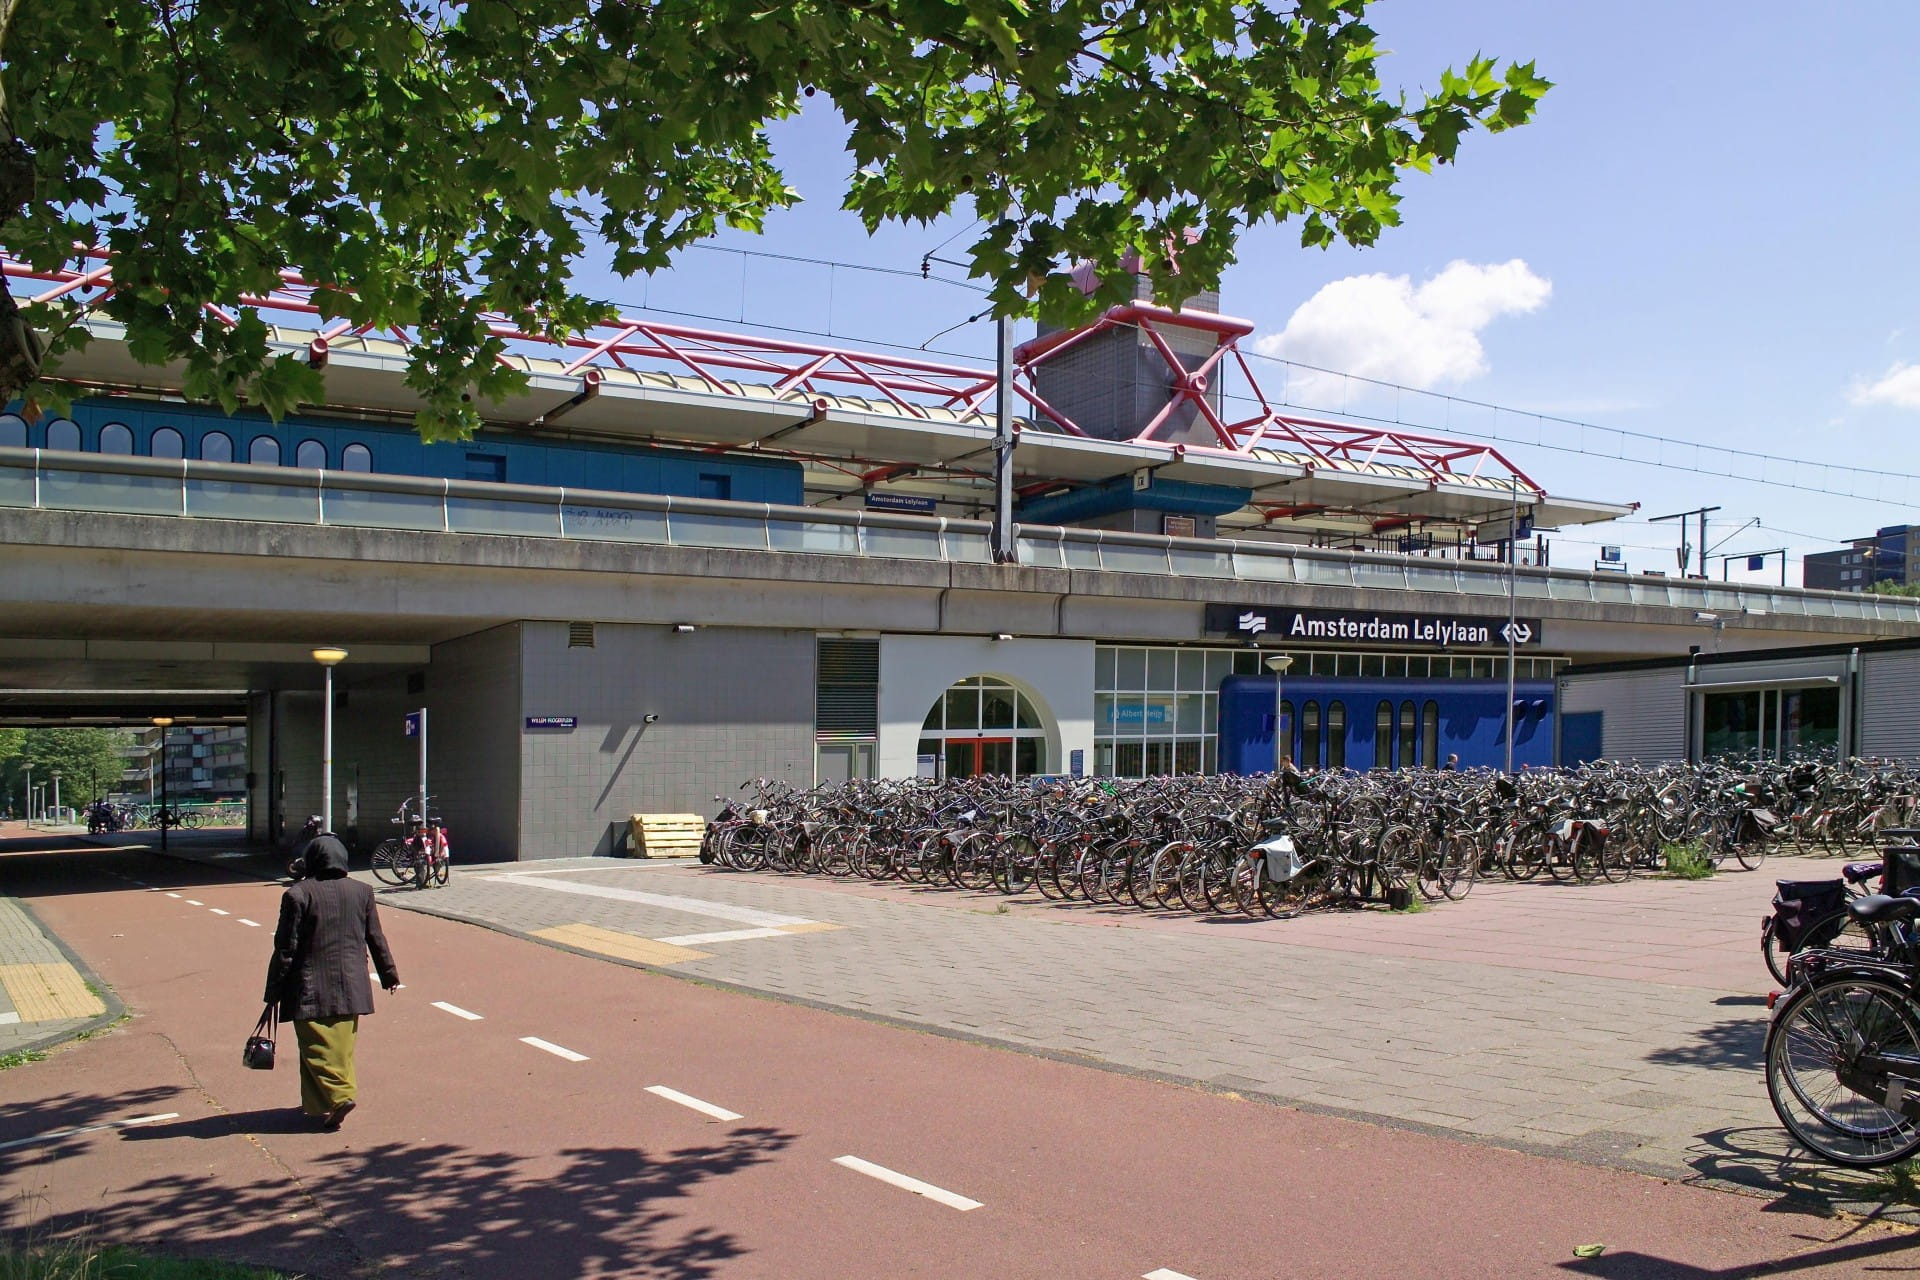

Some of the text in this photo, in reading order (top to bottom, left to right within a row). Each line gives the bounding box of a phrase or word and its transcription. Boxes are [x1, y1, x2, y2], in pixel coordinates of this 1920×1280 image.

[871, 495, 929, 506] Amsterdam Lelylaan
[1290, 613, 1489, 646] Amsterdam Lelylaan
[1121, 708, 1143, 718] Albert
